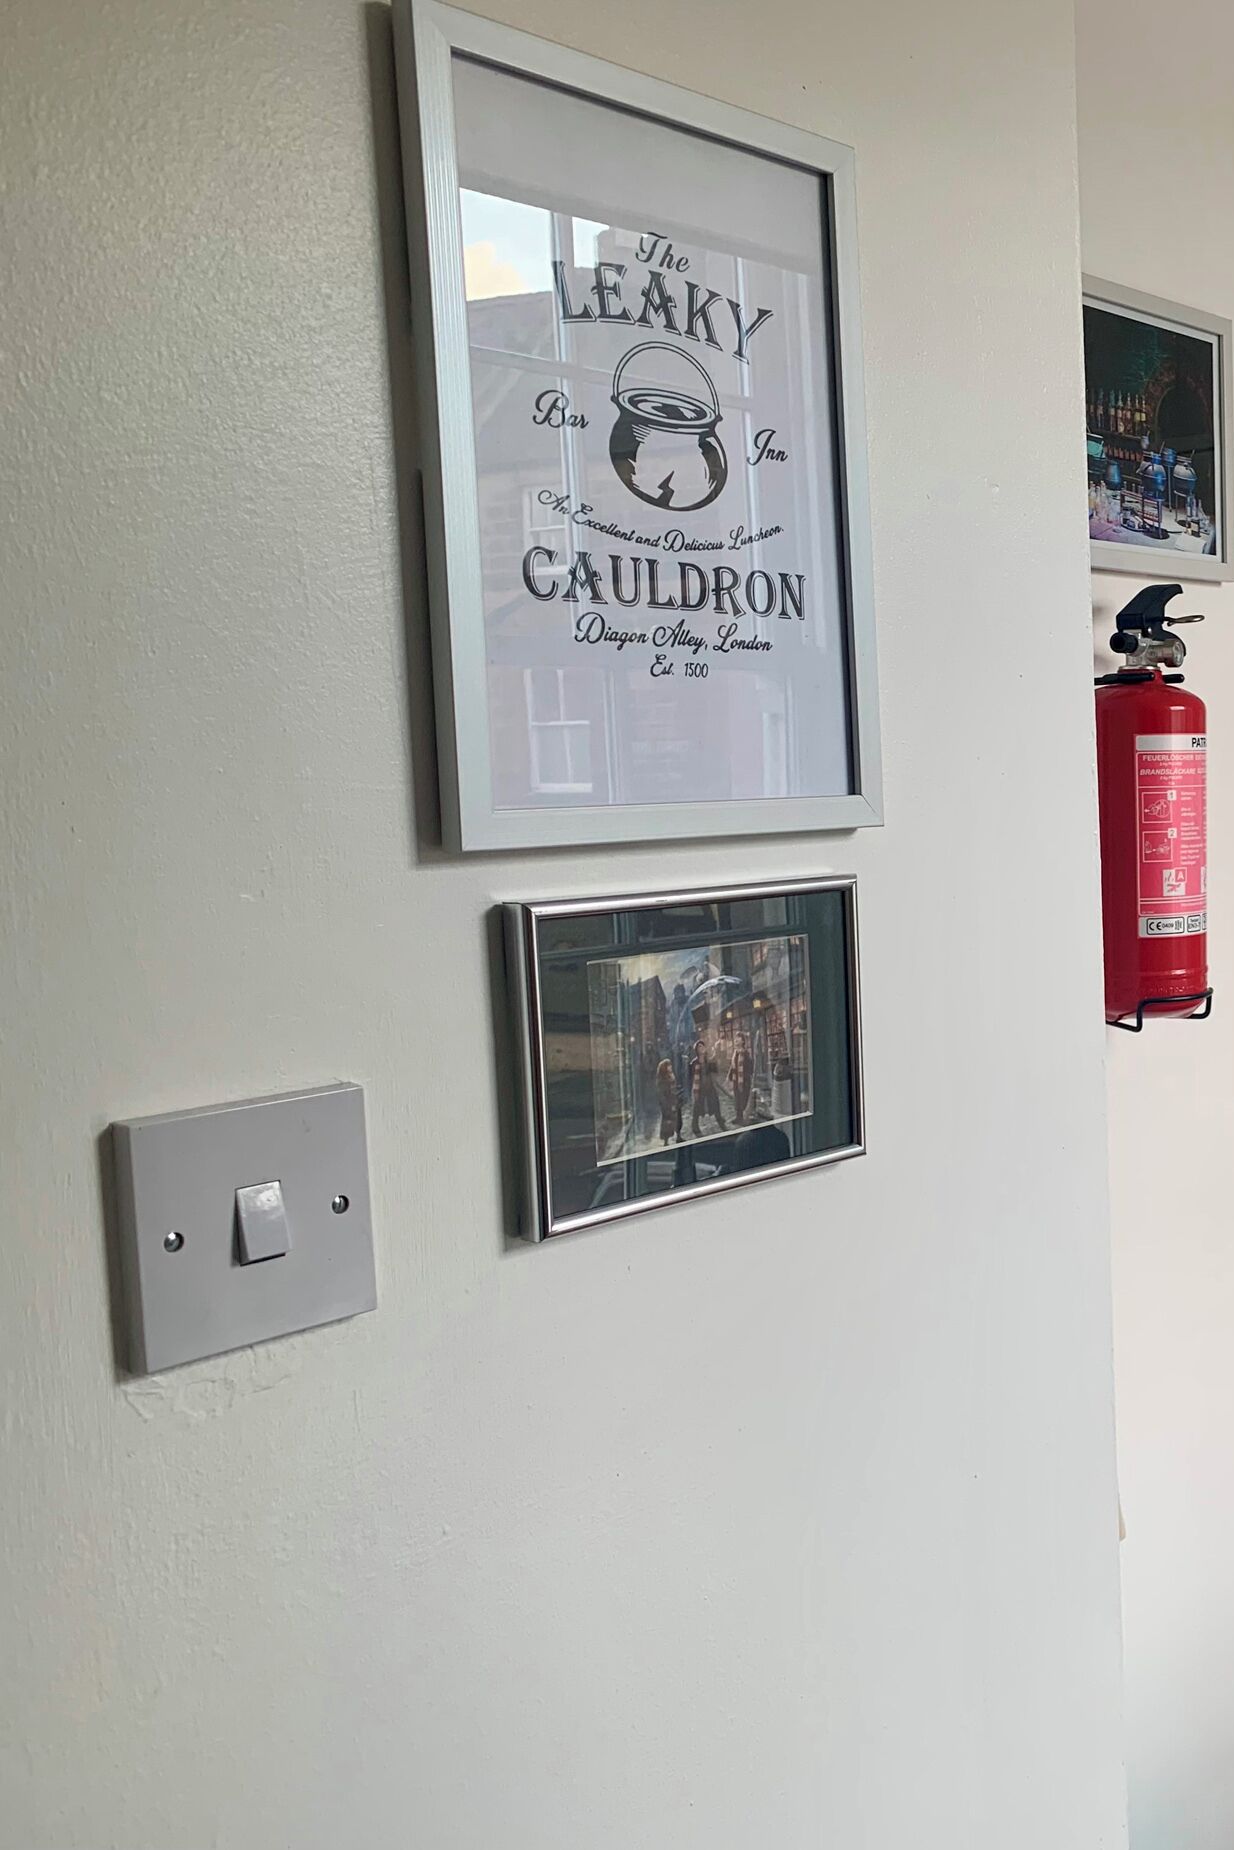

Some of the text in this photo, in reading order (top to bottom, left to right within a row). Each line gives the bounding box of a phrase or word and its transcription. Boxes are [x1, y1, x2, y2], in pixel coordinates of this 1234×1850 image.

[634, 231, 691, 273] The
[552, 260, 773, 365] LEAKY
[532, 389, 589, 429] Bar
[746, 428, 789, 466] Inn
[537, 489, 570, 515] An
[571, 502, 635, 542] Excellent
[635, 535, 660, 548] and
[521, 544, 806, 620] CAULDRON
[574, 611, 773, 656] Diagon Alley, London
[650, 653, 709, 679] Est. 1500
